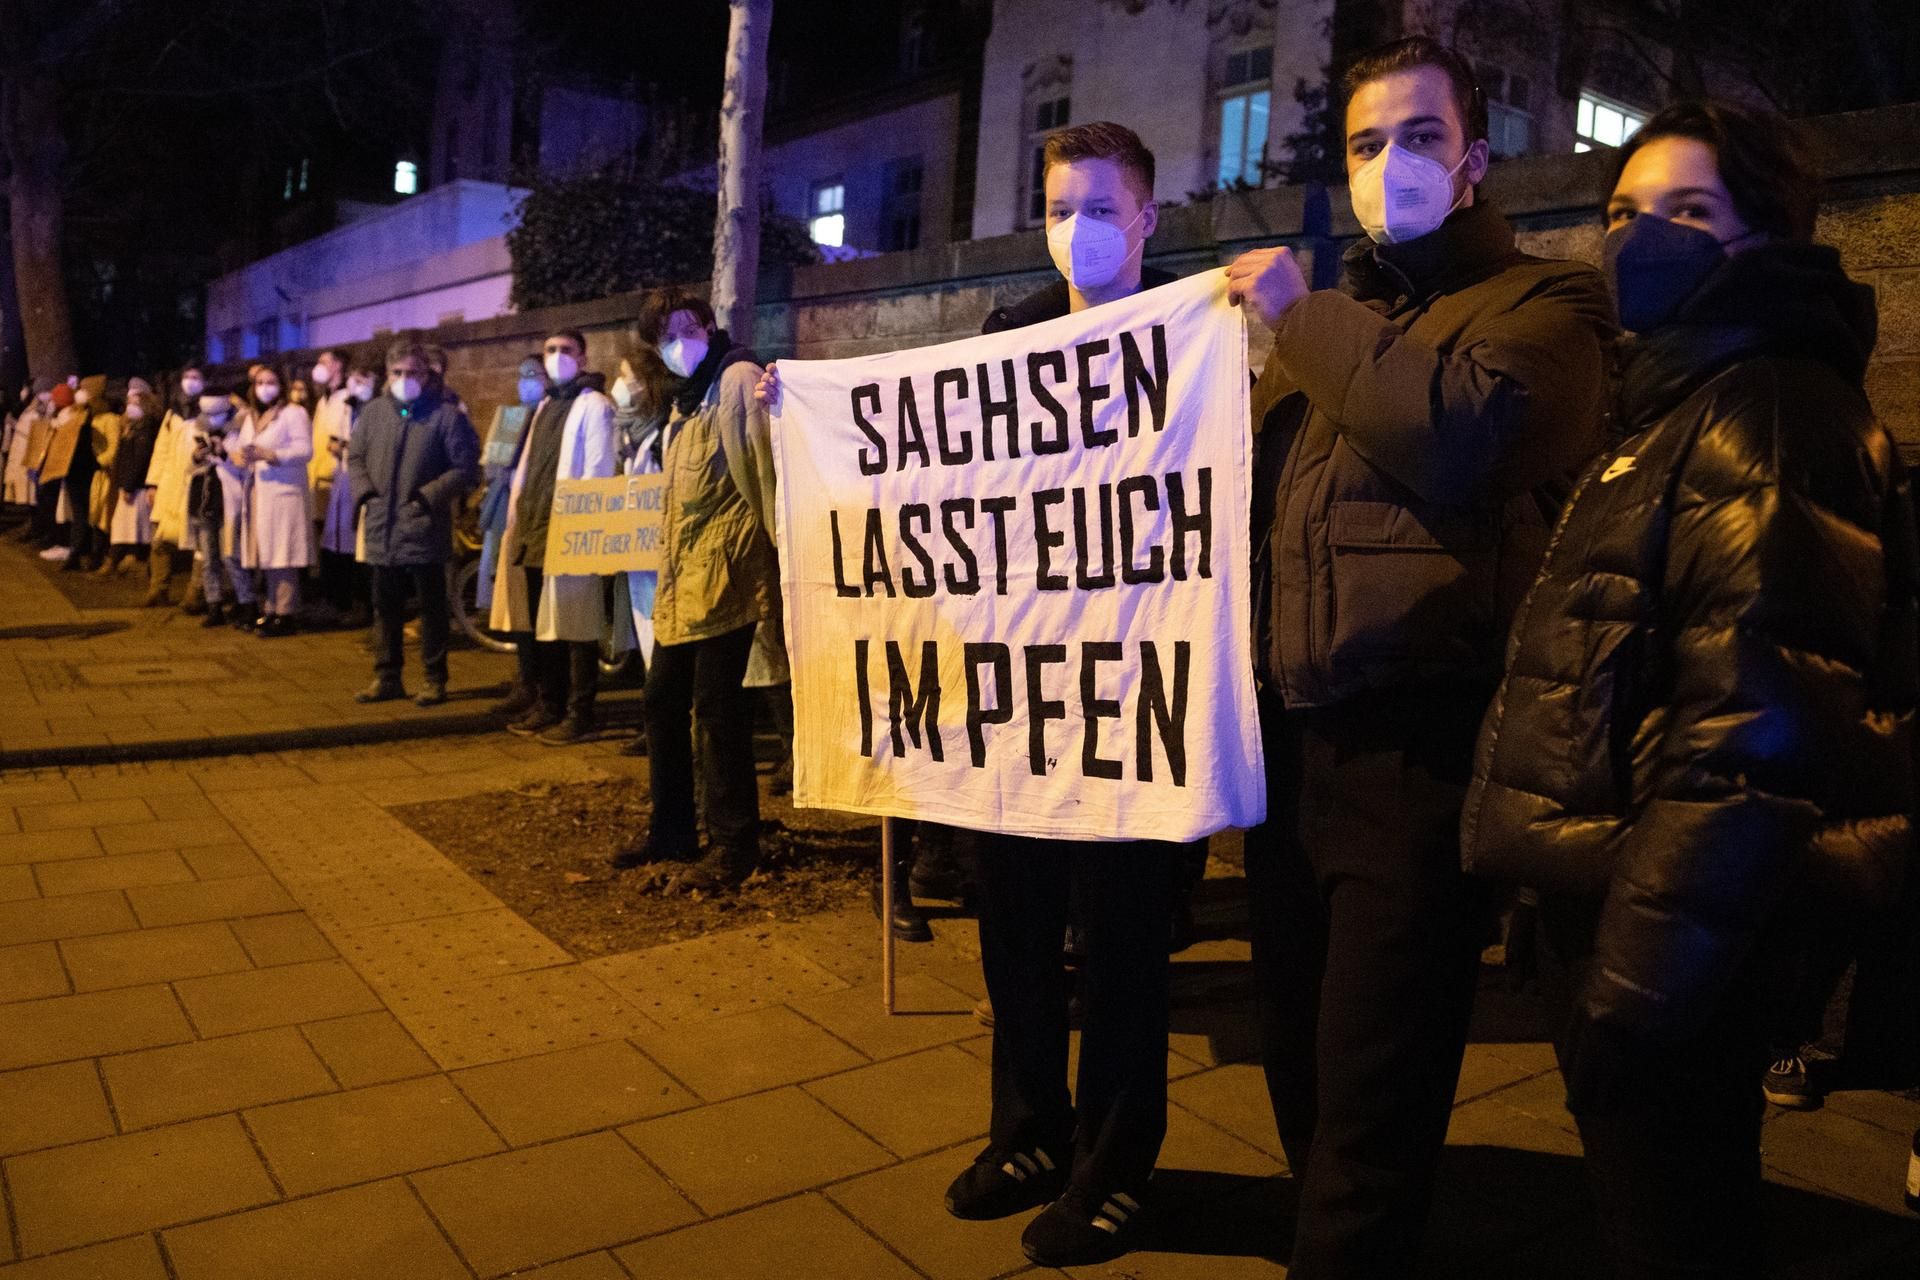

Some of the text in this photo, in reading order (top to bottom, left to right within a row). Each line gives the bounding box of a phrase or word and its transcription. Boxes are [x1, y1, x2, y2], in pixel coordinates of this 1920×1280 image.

[850, 324, 1169, 476] SACHSEN
[561, 529, 604, 556] STATT
[830, 466, 1213, 598] LASST EUCH
[855, 639, 1191, 787] IMPFEN
